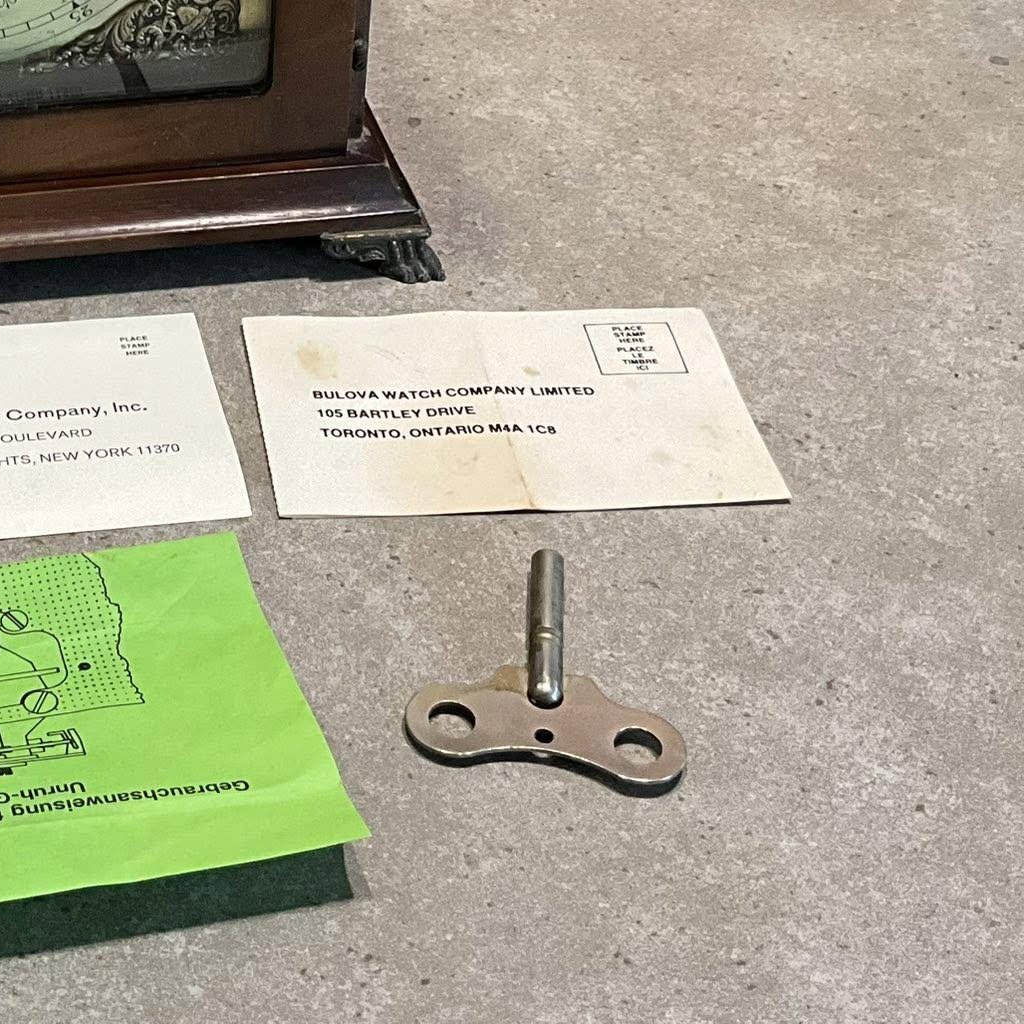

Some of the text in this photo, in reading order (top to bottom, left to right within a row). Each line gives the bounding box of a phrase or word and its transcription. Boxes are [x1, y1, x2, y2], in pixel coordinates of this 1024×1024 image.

[69, 4, 93, 23] 25
[616, 345, 654, 353] PLACEZ
[312, 385, 595, 400] BULOVA WATCH COMPANY LIMITED
[6, 403, 109, 422] Company,
[112, 401, 148, 414] Inc.
[316, 405, 477, 419] 105 BARTLEY DRIVE
[320, 423, 557, 440] TORONTO, ONTARIO M4A 1C8
[39, 451, 80, 464] NEW
[82, 446, 133, 460] YORK
[136, 442, 181, 456] 11370
[11, 779, 251, 817] Gebrauchsanweisung
